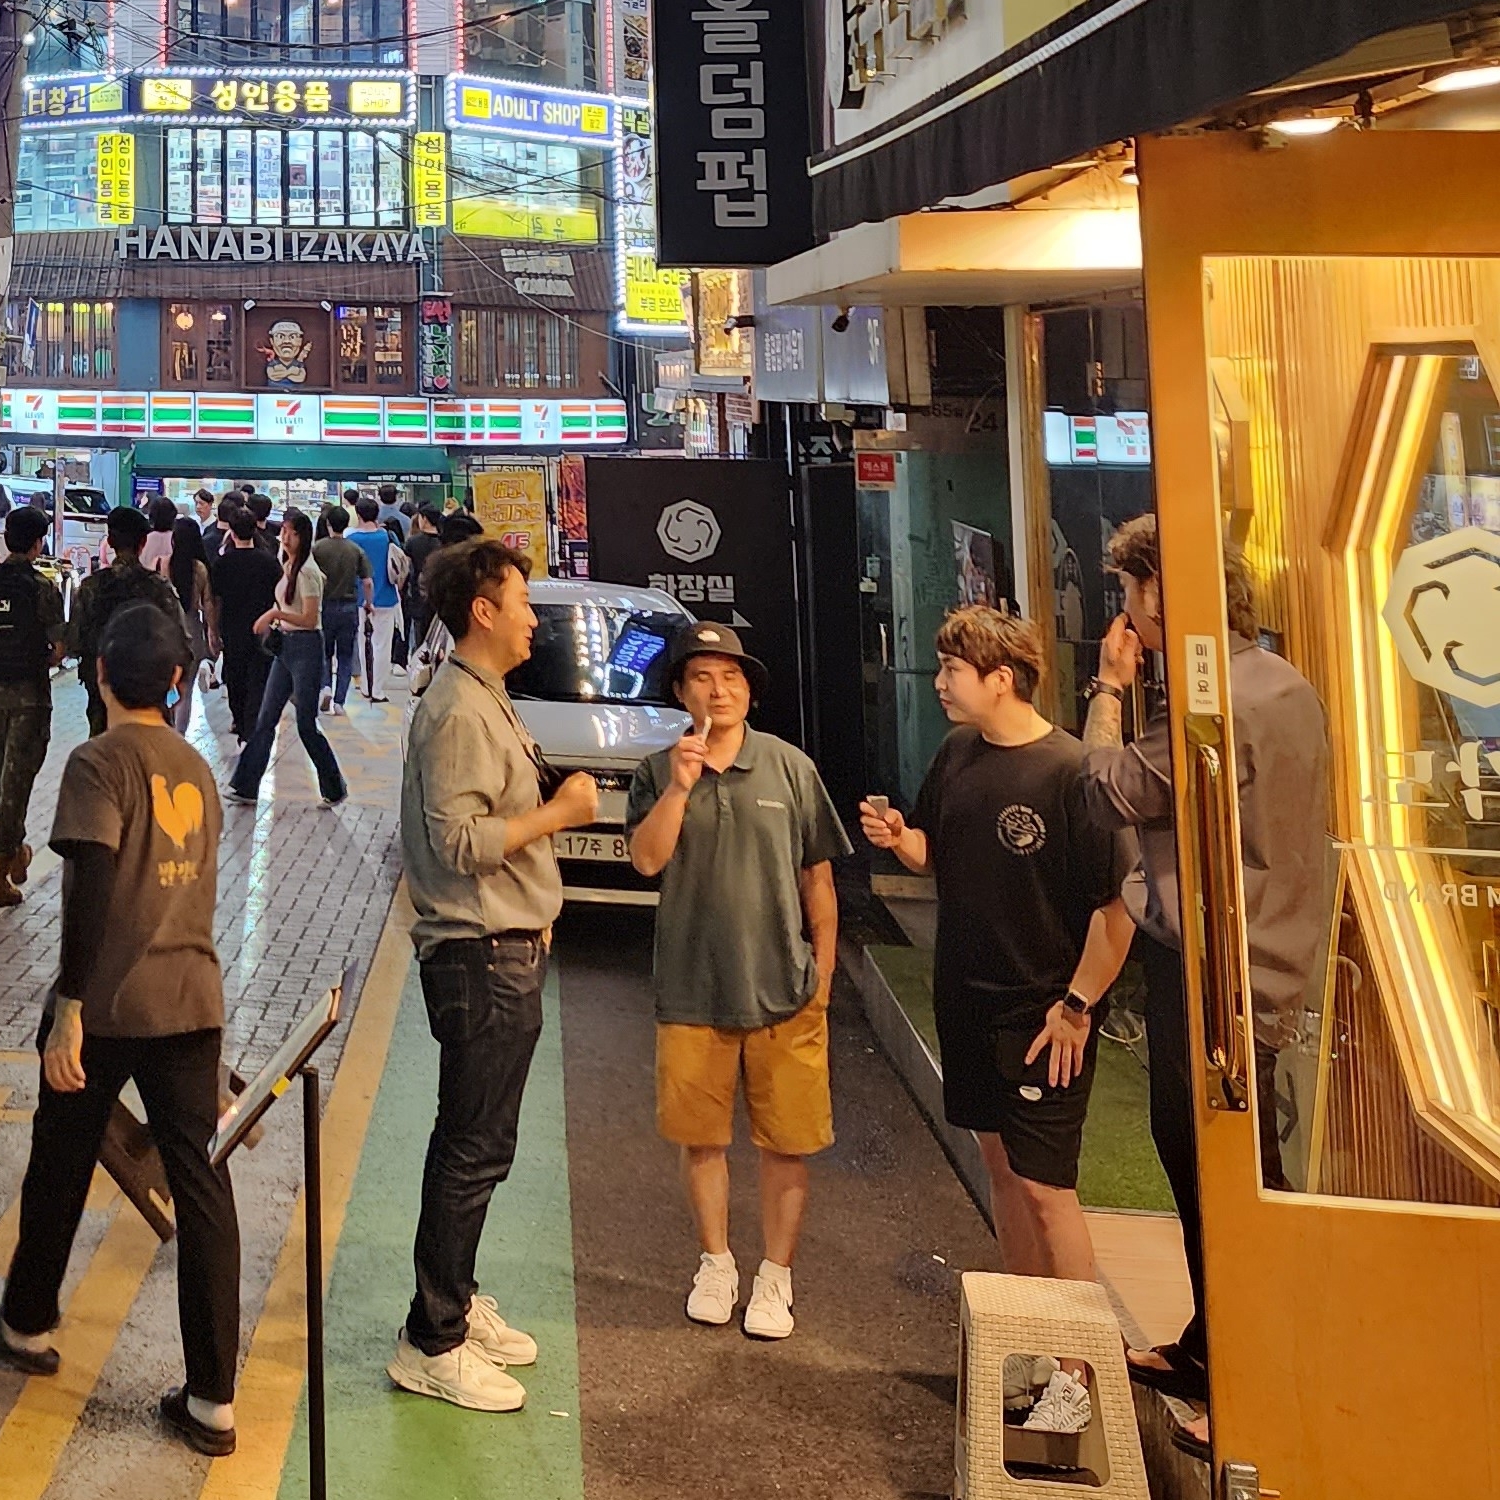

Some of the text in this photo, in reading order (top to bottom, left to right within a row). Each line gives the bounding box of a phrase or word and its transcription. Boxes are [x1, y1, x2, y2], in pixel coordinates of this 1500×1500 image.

[210, 80, 334, 114] 성인용품
[492, 95, 581, 128] ADULT SHOP
[118, 224, 430, 264] HANABI IZAKAYA
[647, 574, 736, 604] 화장실
[1195, 642, 1210, 694] 미세요
